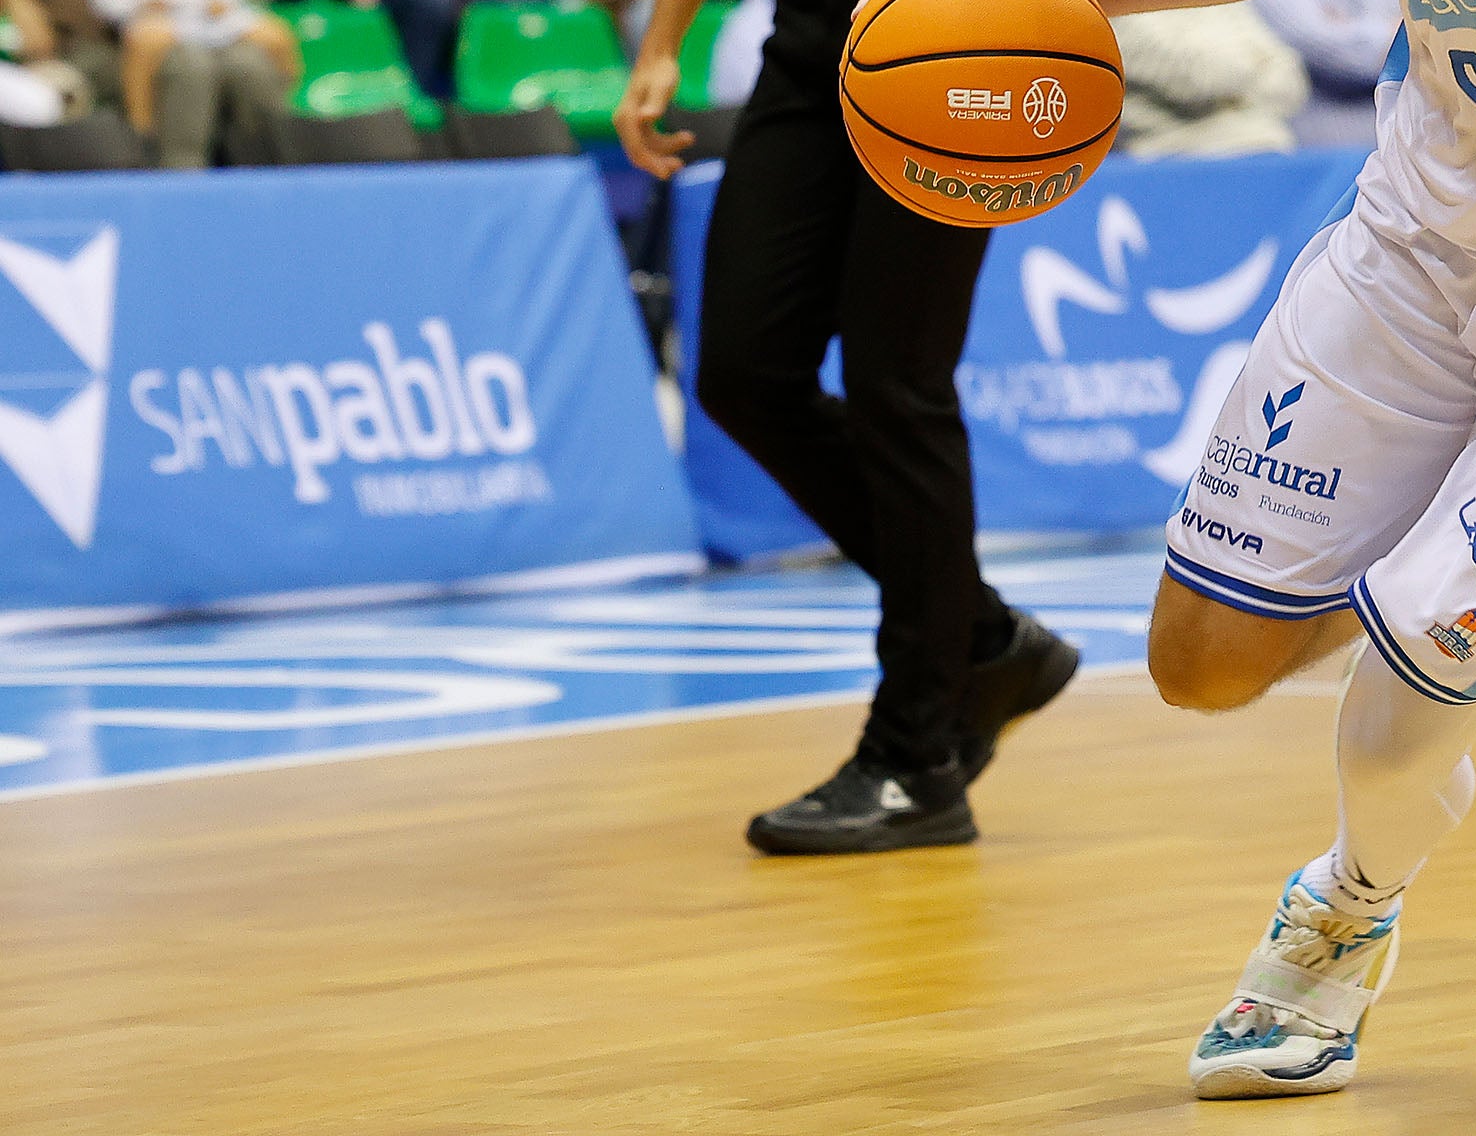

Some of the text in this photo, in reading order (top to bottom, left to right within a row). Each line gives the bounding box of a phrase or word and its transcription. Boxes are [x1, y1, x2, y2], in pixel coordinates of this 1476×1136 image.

[947, 88, 1012, 110] FEB
[947, 110, 1011, 121] PRIMERA
[903, 156, 1083, 212] Wilson
[128, 317, 538, 504] SANpablo
[1206, 434, 1343, 501] cajarural
[1181, 507, 1264, 555] GIVOVA
[1258, 494, 1331, 527] Fundación
